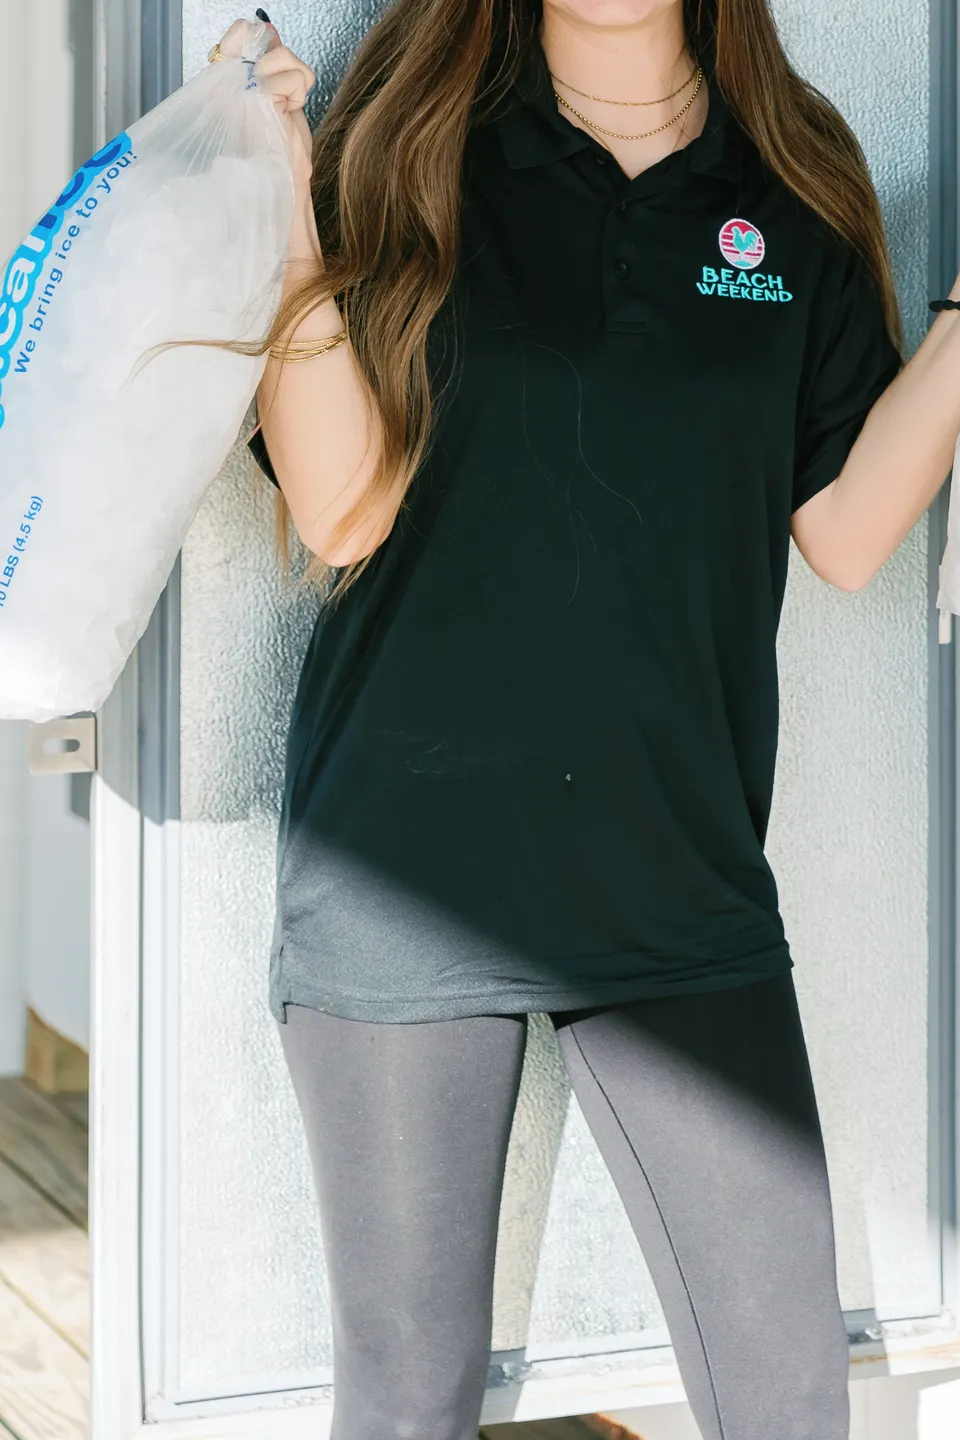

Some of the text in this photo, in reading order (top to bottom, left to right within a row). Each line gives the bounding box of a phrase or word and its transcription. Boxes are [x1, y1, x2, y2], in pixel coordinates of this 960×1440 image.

[14, 150, 138, 375] We bring ice to you!
[695, 281, 794, 303] WEEKEND
[702, 265, 784, 290] BEACH
[0, 555, 20, 588] LBS
[12, 523, 32, 552] (4.5
[23, 495, 44, 521] kg)
